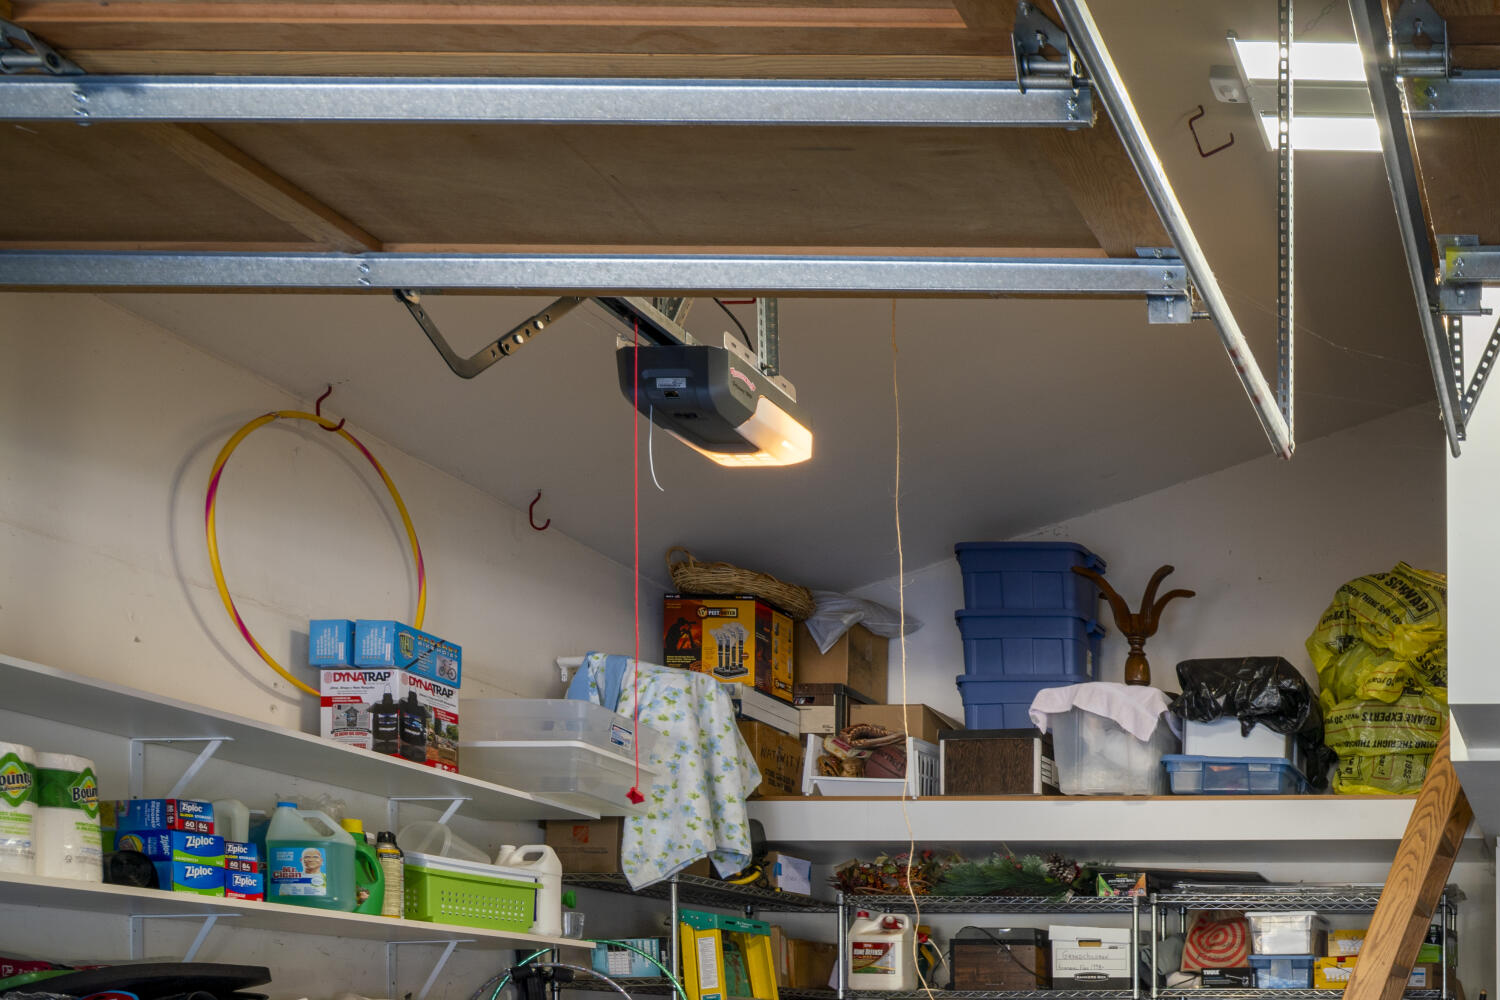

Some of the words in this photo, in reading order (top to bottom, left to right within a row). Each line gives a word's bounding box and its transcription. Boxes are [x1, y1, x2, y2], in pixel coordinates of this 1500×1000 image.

[333, 671, 391, 685] DYNATRAP
[408, 675, 454, 697] DYNATRAP
[1361, 711, 1404, 722] EXPERTS
[1373, 740, 1396, 749] RIGHT
[1414, 740, 1437, 749] OING
[0, 772, 32, 786] ounty
[72, 785, 98, 802] Boun
[182, 802, 203, 813] Ziploc
[186, 835, 215, 849] Ziploc
[227, 843, 248, 854] Ziploc
[185, 865, 213, 879] Ziploc
[273, 871, 302, 879] Clean
[234, 874, 258, 887] Ziploc
